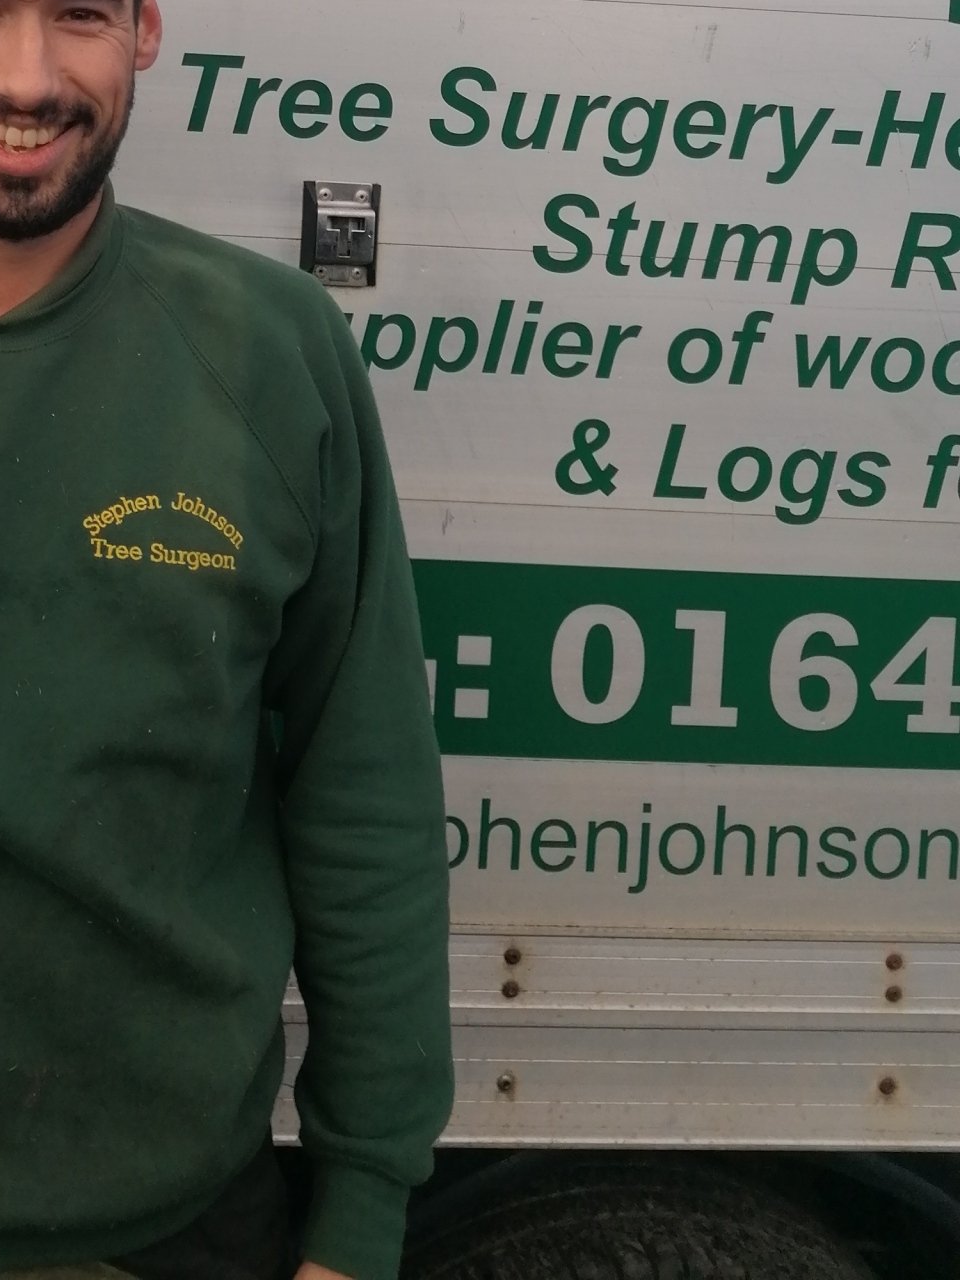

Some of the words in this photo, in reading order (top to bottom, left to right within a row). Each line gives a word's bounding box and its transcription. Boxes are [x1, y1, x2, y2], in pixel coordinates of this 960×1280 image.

[181, 52, 394, 143] Tree
[429, 66, 960, 184] Surgery-H
[532, 193, 858, 305] Stump
[343, 299, 642, 392] pplier
[666, 311, 774, 385] of
[83, 493, 163, 536] Stephen
[171, 492, 244, 550] Johnson
[555, 418, 619, 497] &
[652, 423, 891, 525] Logs
[90, 538, 143, 561] Tree
[150, 543, 236, 571] Surgeon
[550, 603, 960, 734] 0164
